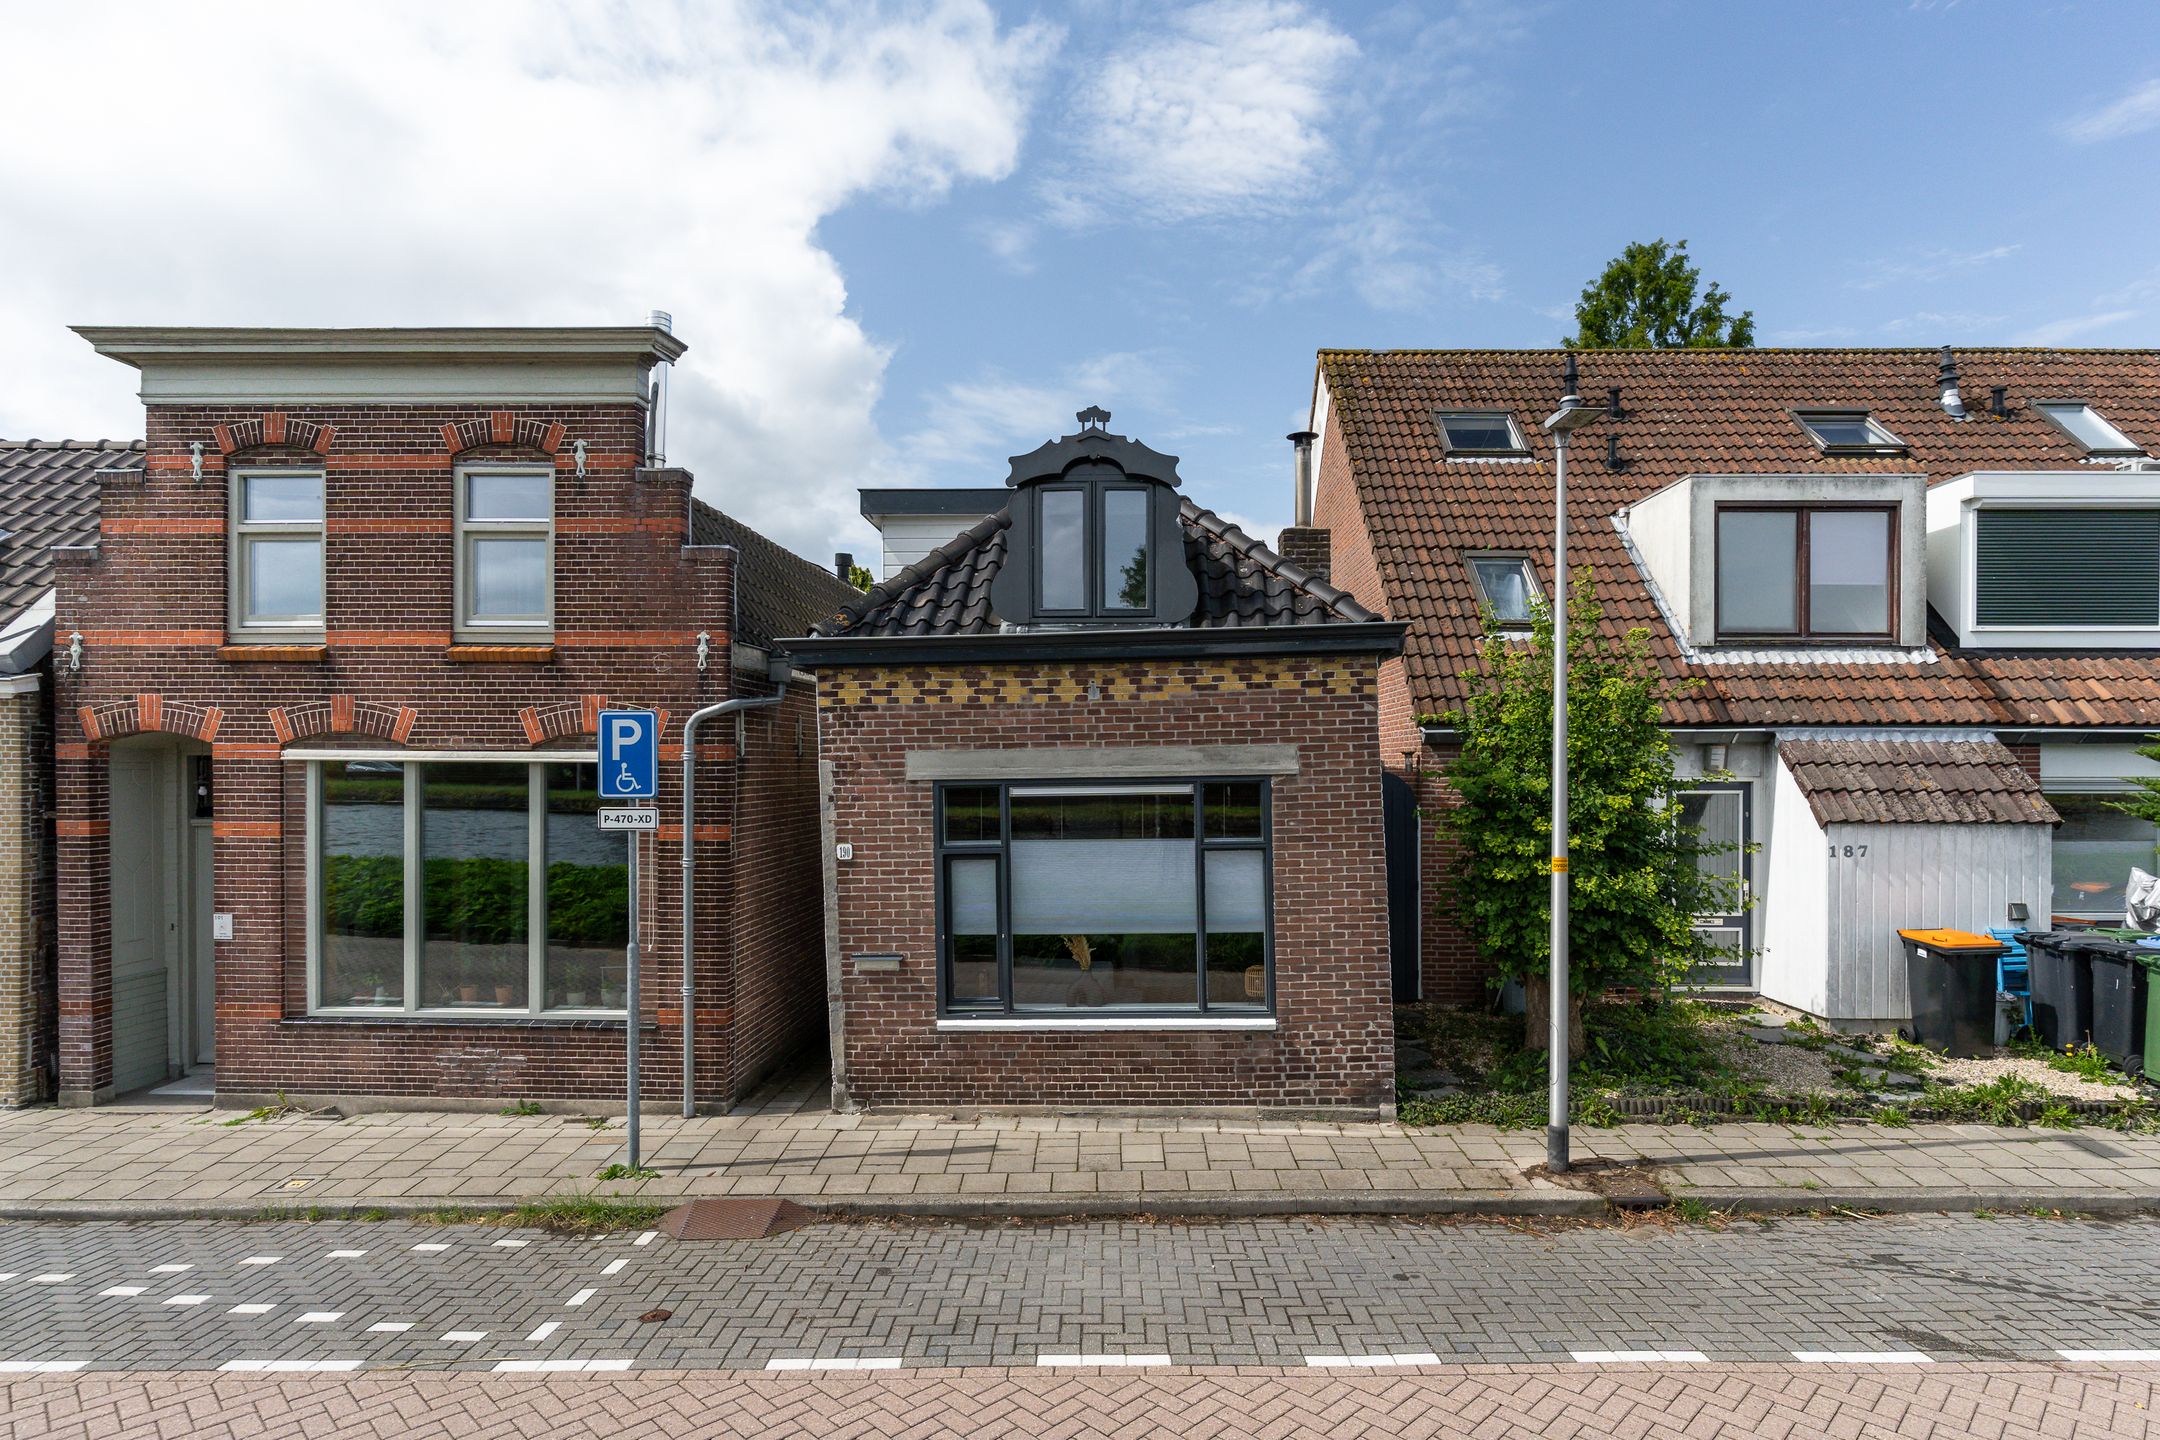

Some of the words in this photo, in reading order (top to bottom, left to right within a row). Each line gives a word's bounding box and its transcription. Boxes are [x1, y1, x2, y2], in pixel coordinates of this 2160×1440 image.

[612, 719, 642, 760] P
[604, 814, 652, 823] P-470-XD
[840, 846, 850, 858] 190
[1829, 845, 1868, 858] 187
